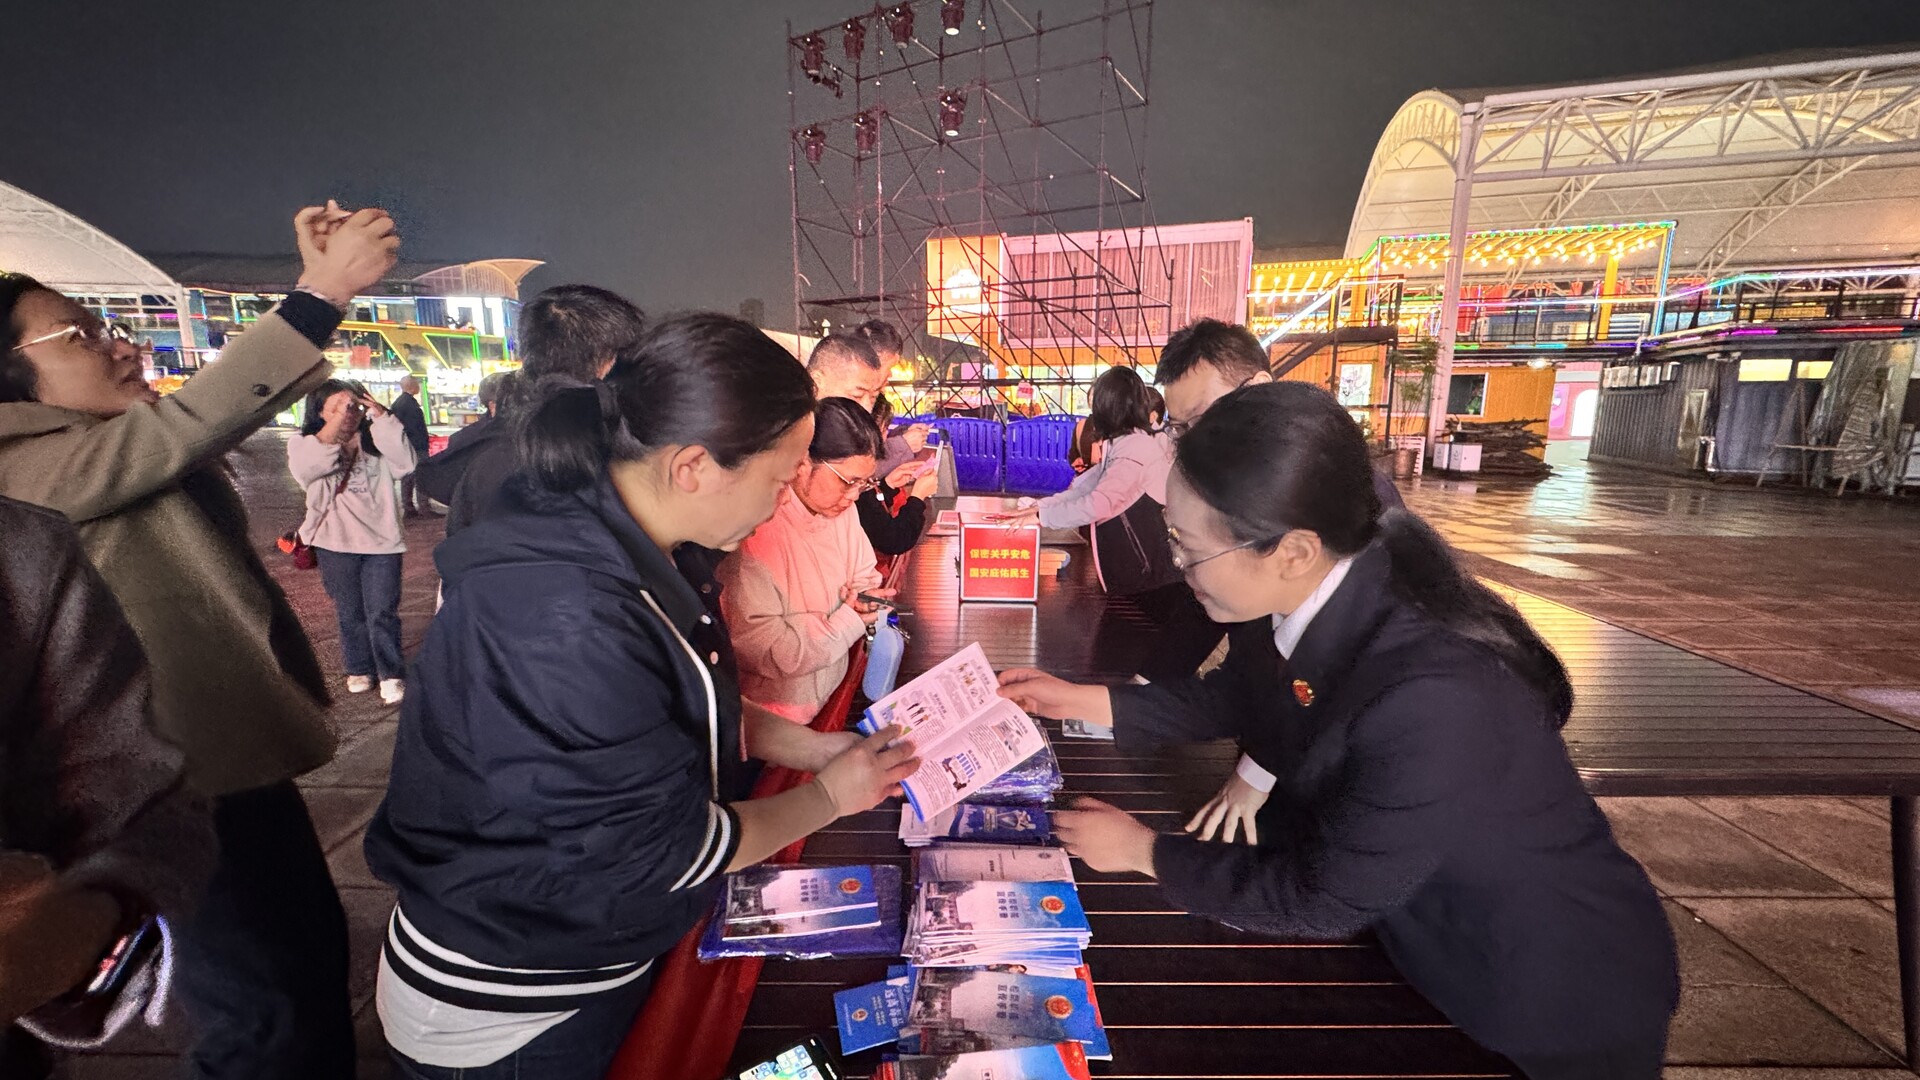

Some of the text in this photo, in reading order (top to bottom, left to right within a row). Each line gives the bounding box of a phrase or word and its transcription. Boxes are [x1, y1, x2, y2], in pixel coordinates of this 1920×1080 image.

[970, 548, 1031, 560] 保密关乎安危
[969, 567, 1030, 578] 国安庇佑民生
